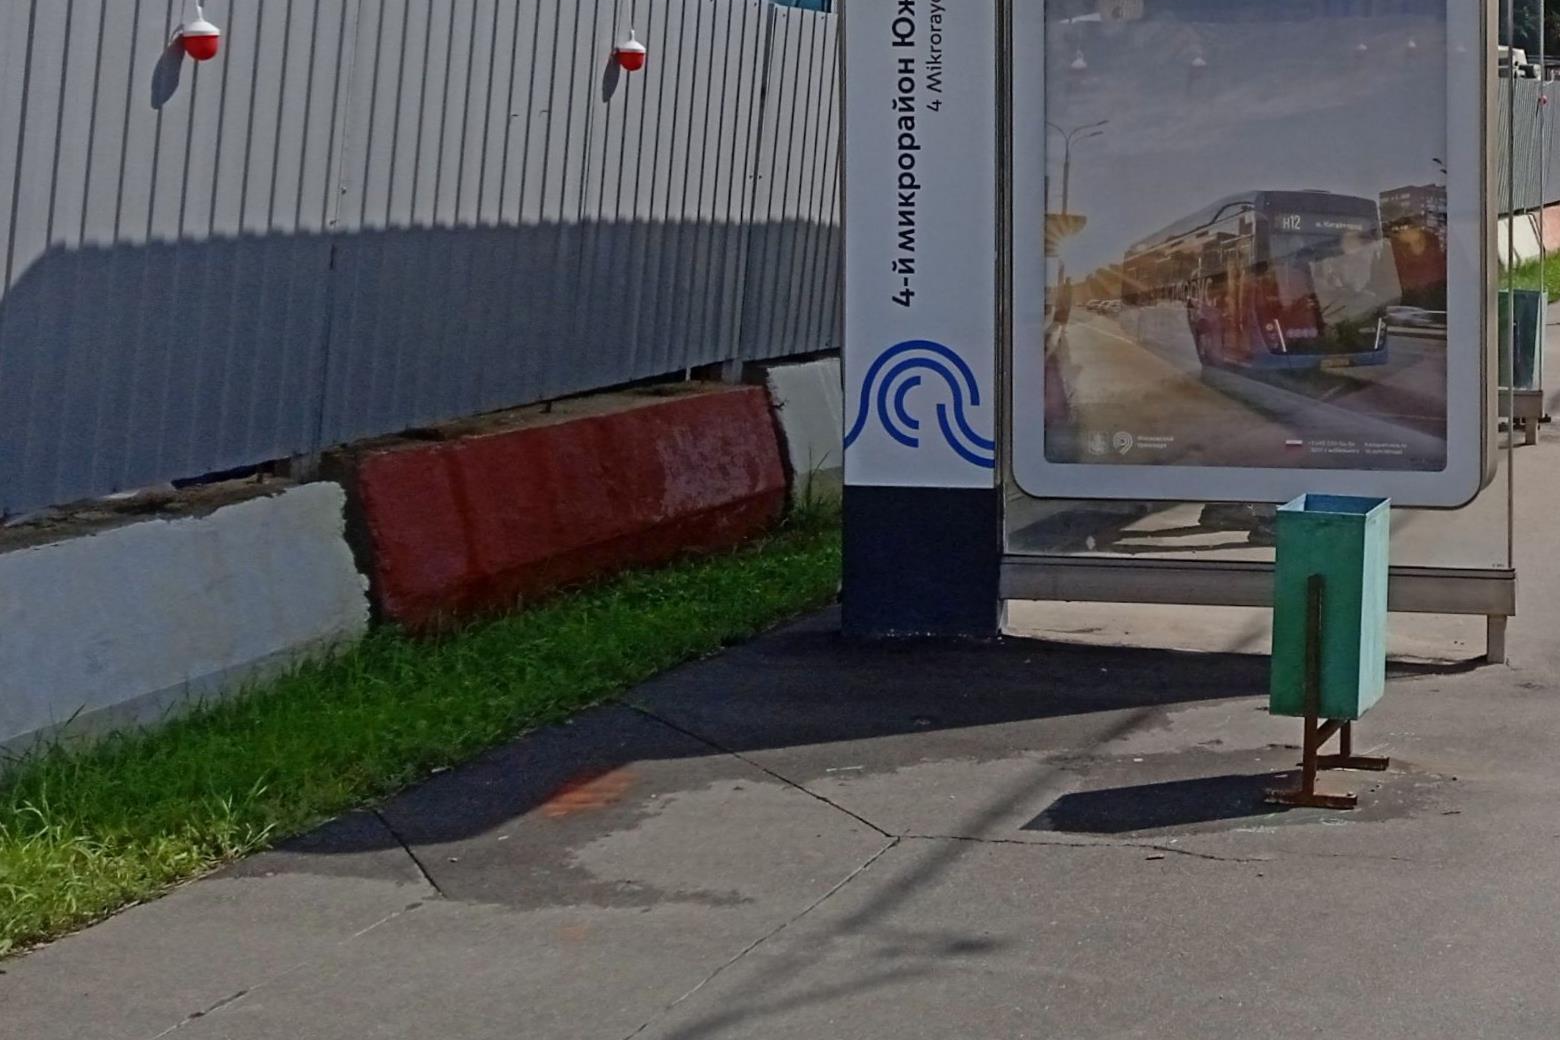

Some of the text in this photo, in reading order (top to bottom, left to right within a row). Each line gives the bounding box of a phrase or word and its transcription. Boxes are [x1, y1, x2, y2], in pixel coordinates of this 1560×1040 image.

[926, 99, 942, 112] 4
[891, 58, 920, 252] микрорайон
[891, 257, 915, 308] 4-й
